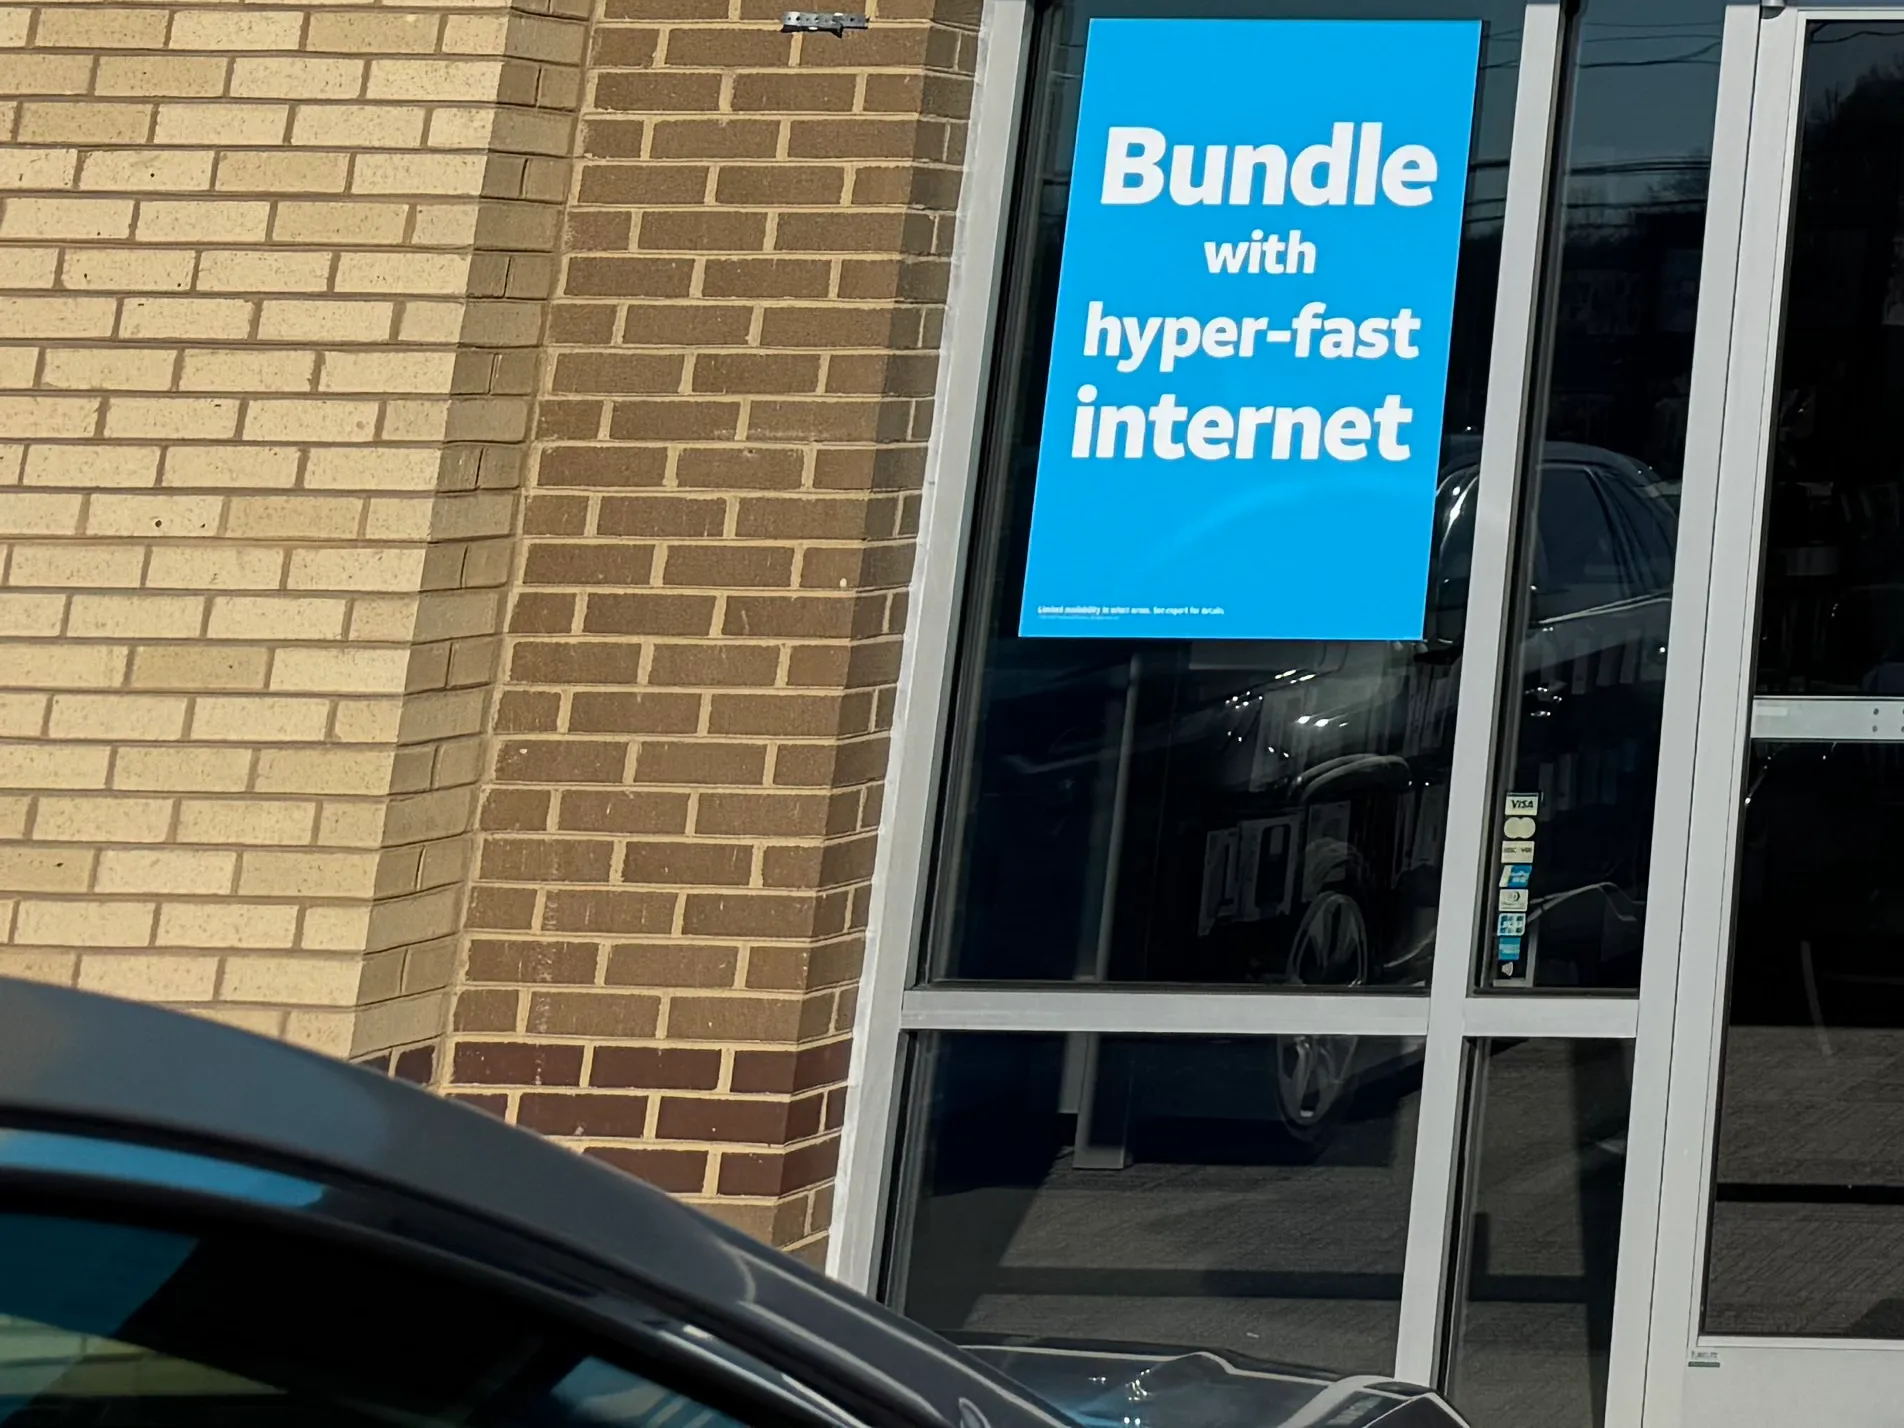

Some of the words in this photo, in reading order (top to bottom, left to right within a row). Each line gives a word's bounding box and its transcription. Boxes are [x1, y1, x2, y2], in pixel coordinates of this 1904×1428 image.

[1100, 121, 1438, 207] Bundle
[1204, 229, 1317, 275] with
[1083, 301, 1422, 373] hyper-fast
[1071, 384, 1413, 462] internet
